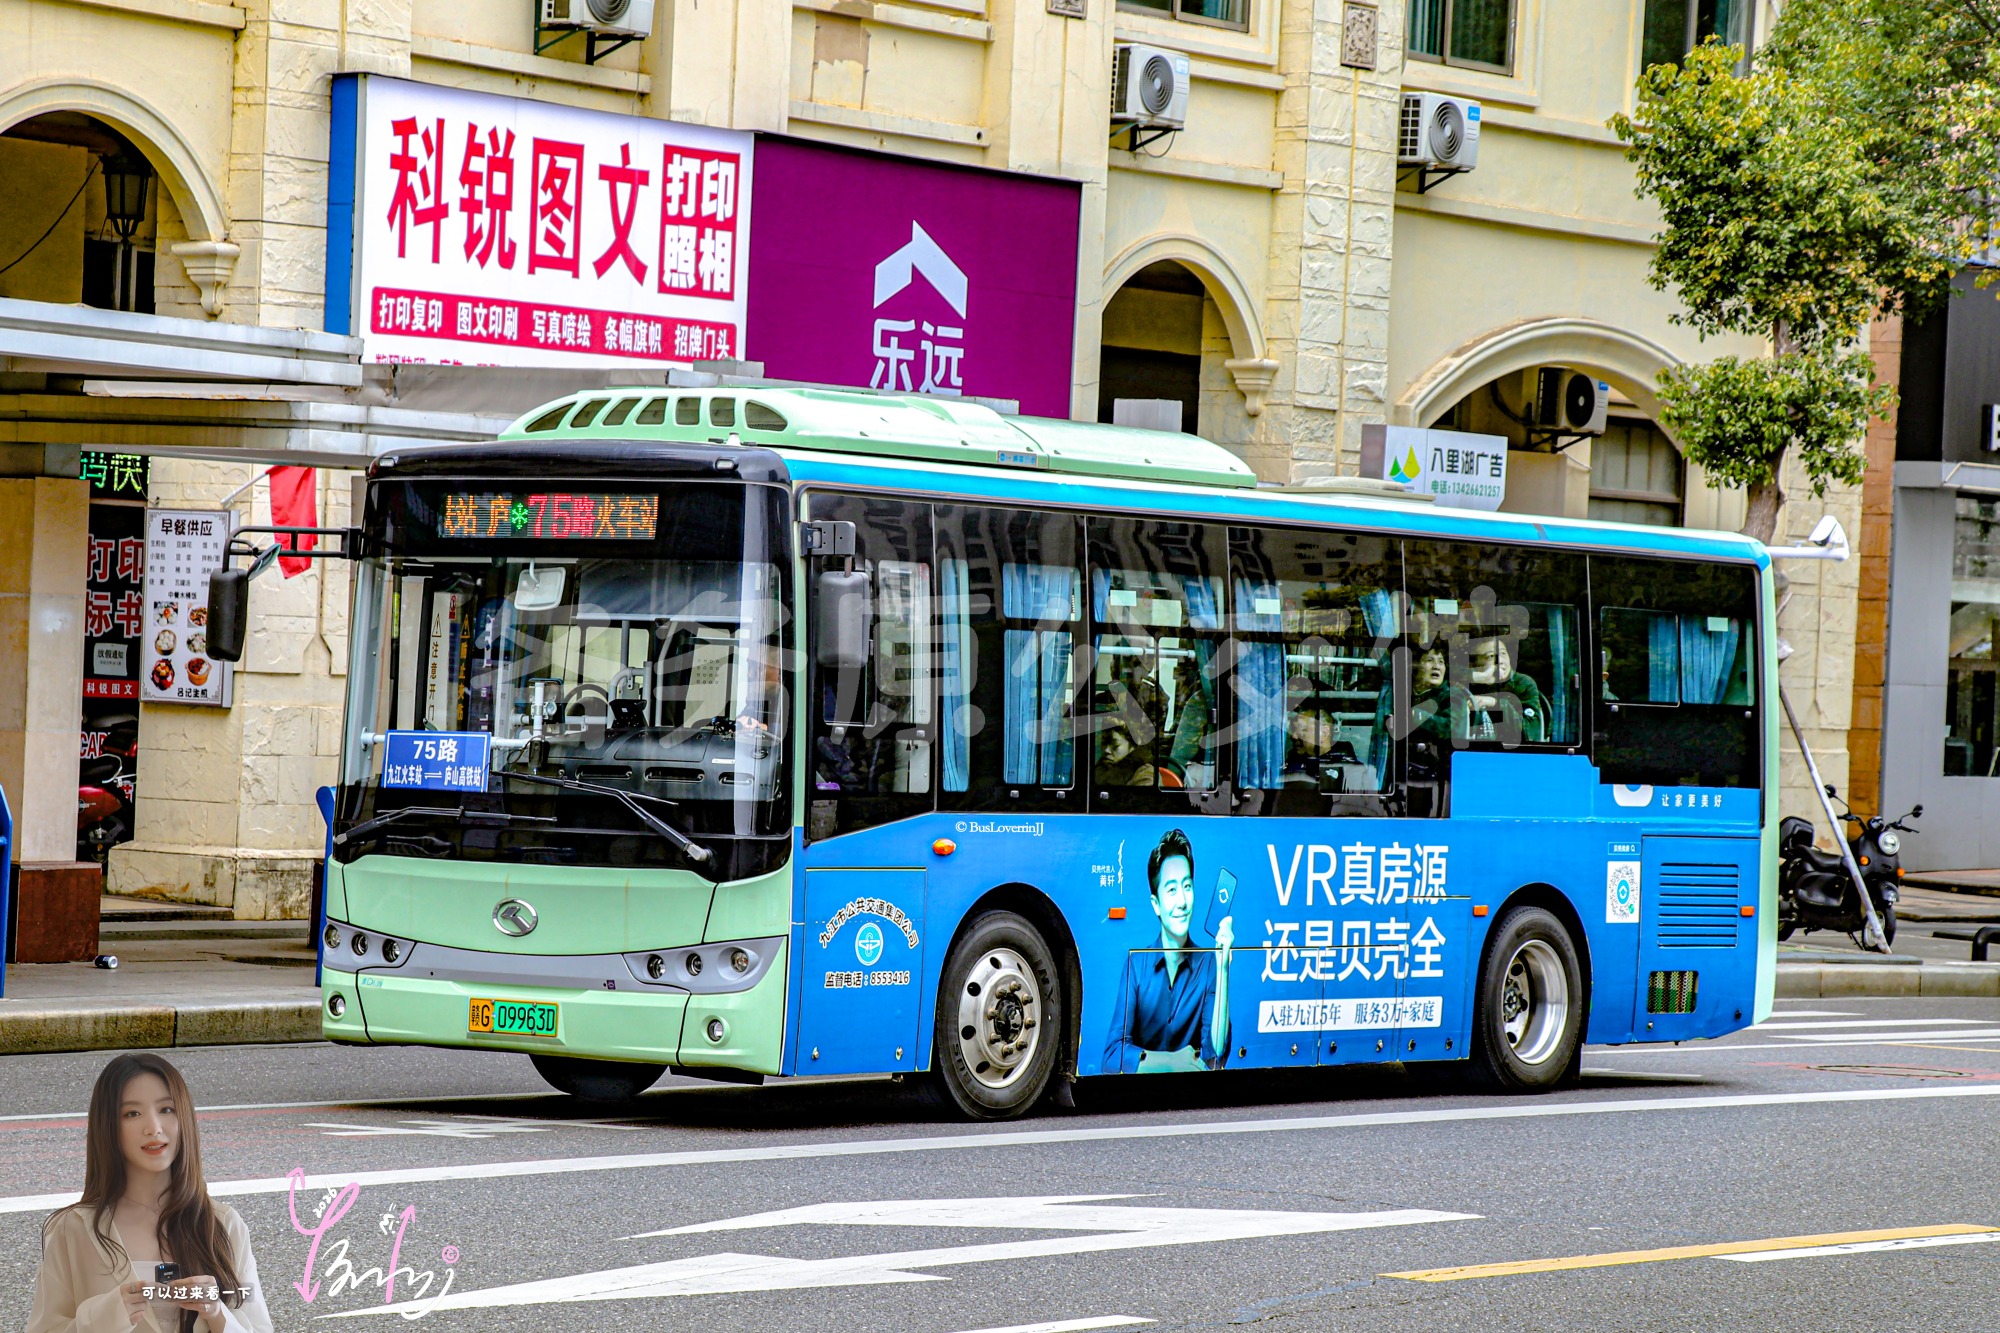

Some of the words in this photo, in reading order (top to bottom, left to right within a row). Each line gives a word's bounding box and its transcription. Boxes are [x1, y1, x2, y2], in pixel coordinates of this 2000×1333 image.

[387, 115, 650, 287] 科锐图文
[665, 153, 735, 223] 打印
[662, 223, 733, 294] 照相
[379, 293, 443, 333] 打印复印
[457, 301, 519, 342] 图文印刷
[532, 309, 591, 348] 写真喷绘
[604, 316, 662, 354] 条幅旗帜
[674, 324, 730, 361] 招牌门头
[869, 318, 965, 397] 乐远
[1431, 447, 1503, 478] 八里湖广告
[161, 518, 213, 536] 早餐供应
[527, 493, 597, 538] 75路
[87, 533, 145, 584] 打印
[85, 589, 143, 639] 标书
[87, 682, 133, 695] 科锐图文
[177, 688, 208, 698] 吕记生煎
[428, 641, 439, 722] 注意开门
[413, 738, 458, 763] 75路
[387, 764, 423, 786] 九江火车站
[444, 765, 482, 788] 庐山高铁站
[1661, 793, 1722, 808] 让家更美好
[1100, 875, 1115, 888] 黄轩
[1266, 841, 1449, 907] VR真房源
[819, 896, 920, 950] 九江市公共交通集团公司
[1261, 916, 1447, 983] 还是贝壳全
[1265, 1003, 1342, 1028] 入驻九江5年
[1354, 1000, 1436, 1025] 服务3万+家庭
